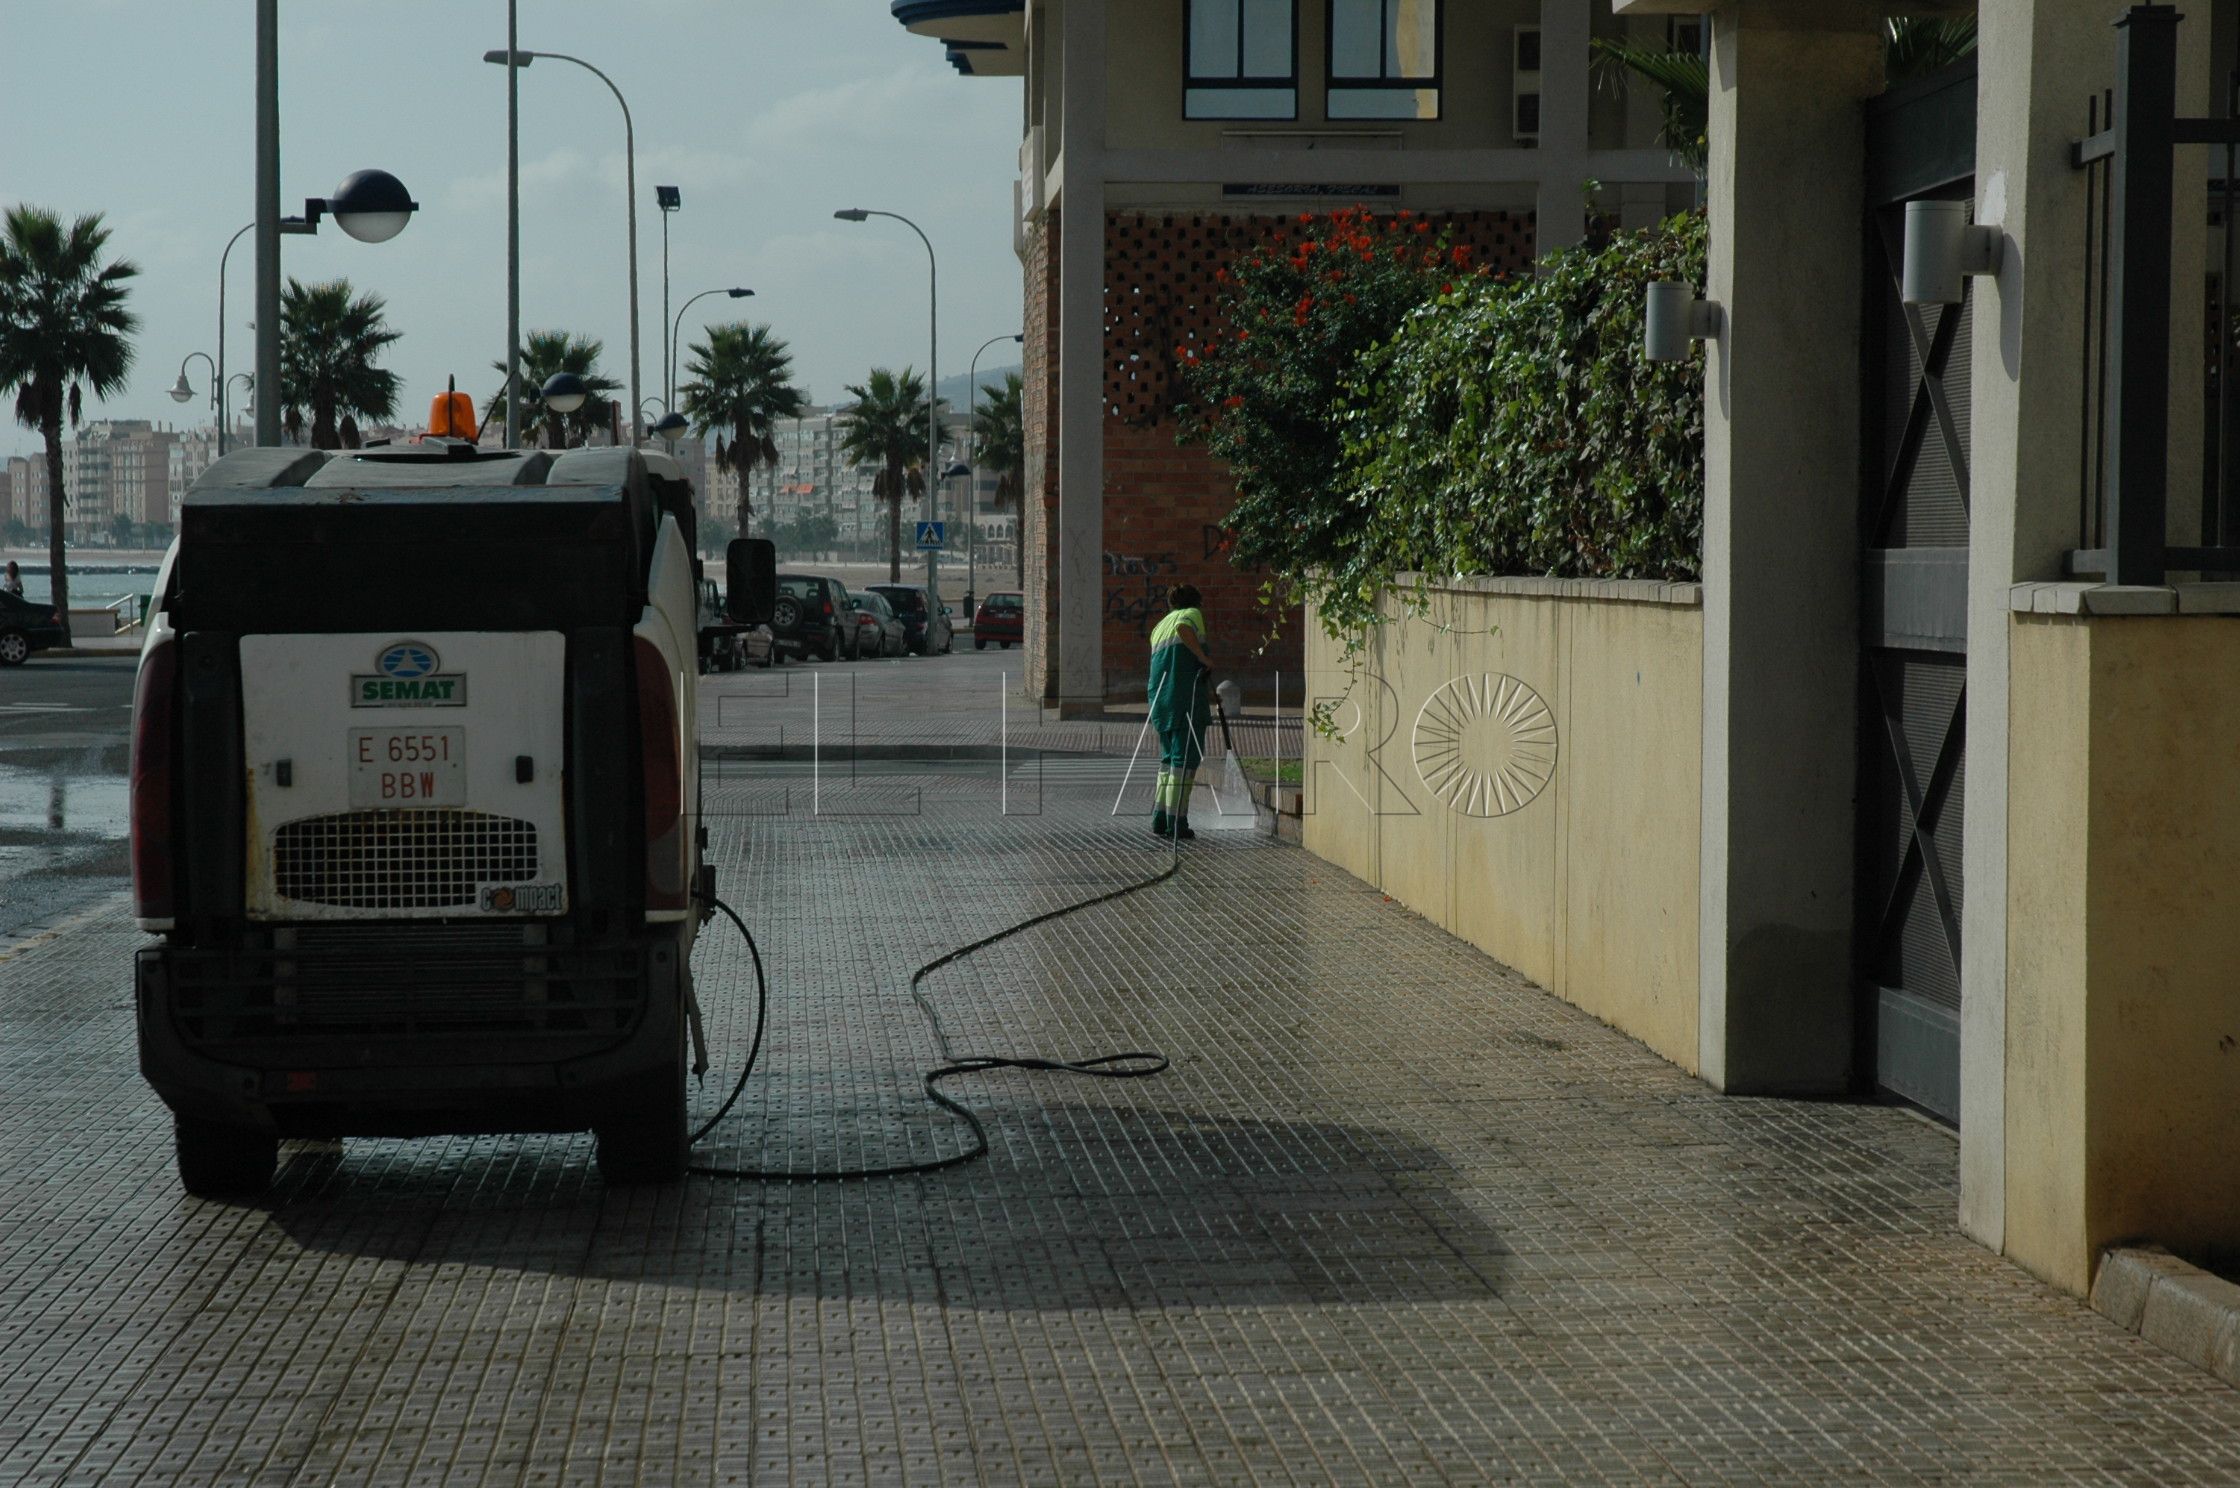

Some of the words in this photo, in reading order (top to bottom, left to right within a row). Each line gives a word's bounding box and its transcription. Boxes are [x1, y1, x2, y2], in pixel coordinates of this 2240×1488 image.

[362, 680, 455, 700] SEMAT
[358, 736, 374, 763] E
[388, 735, 449, 762] 6551
[381, 771, 435, 799] BBW
